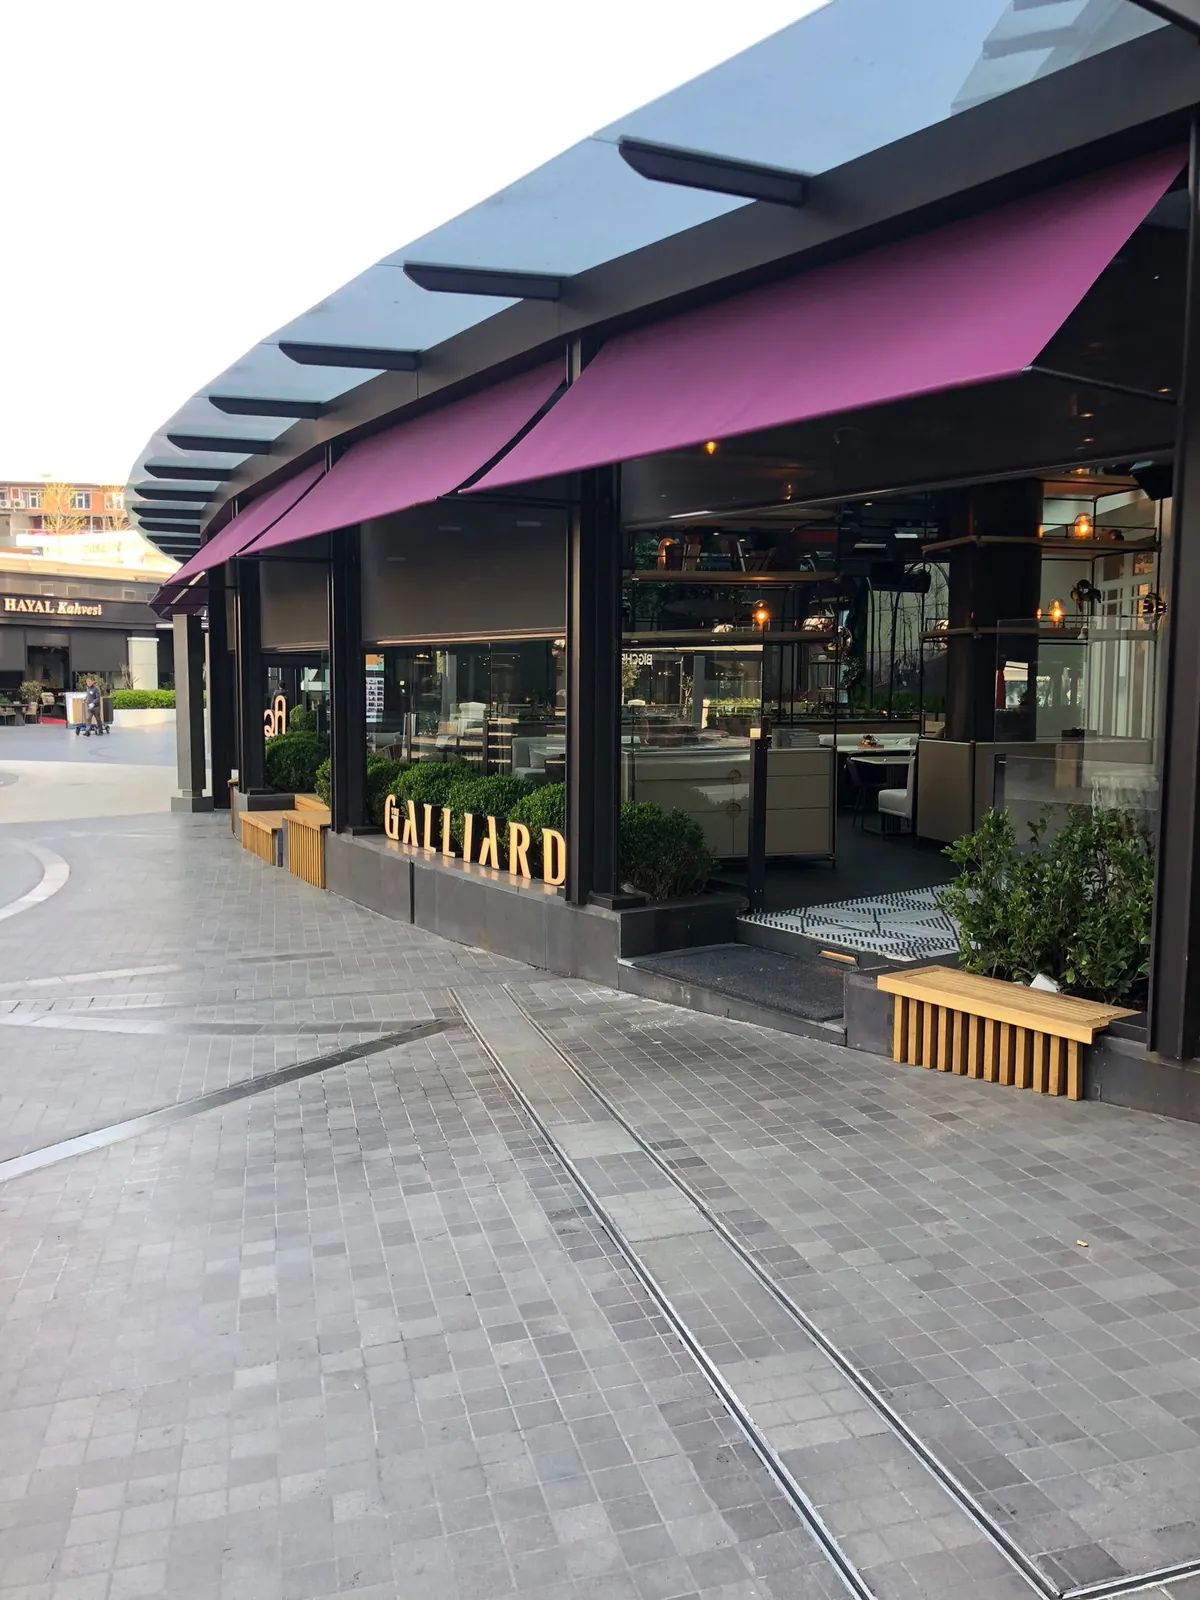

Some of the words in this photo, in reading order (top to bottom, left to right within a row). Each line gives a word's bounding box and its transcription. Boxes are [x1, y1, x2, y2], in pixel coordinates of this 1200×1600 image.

[4, 598, 55, 613] HAYAL
[57, 602, 102, 615] Kahvesi
[385, 794, 566, 886] GALLIARD
